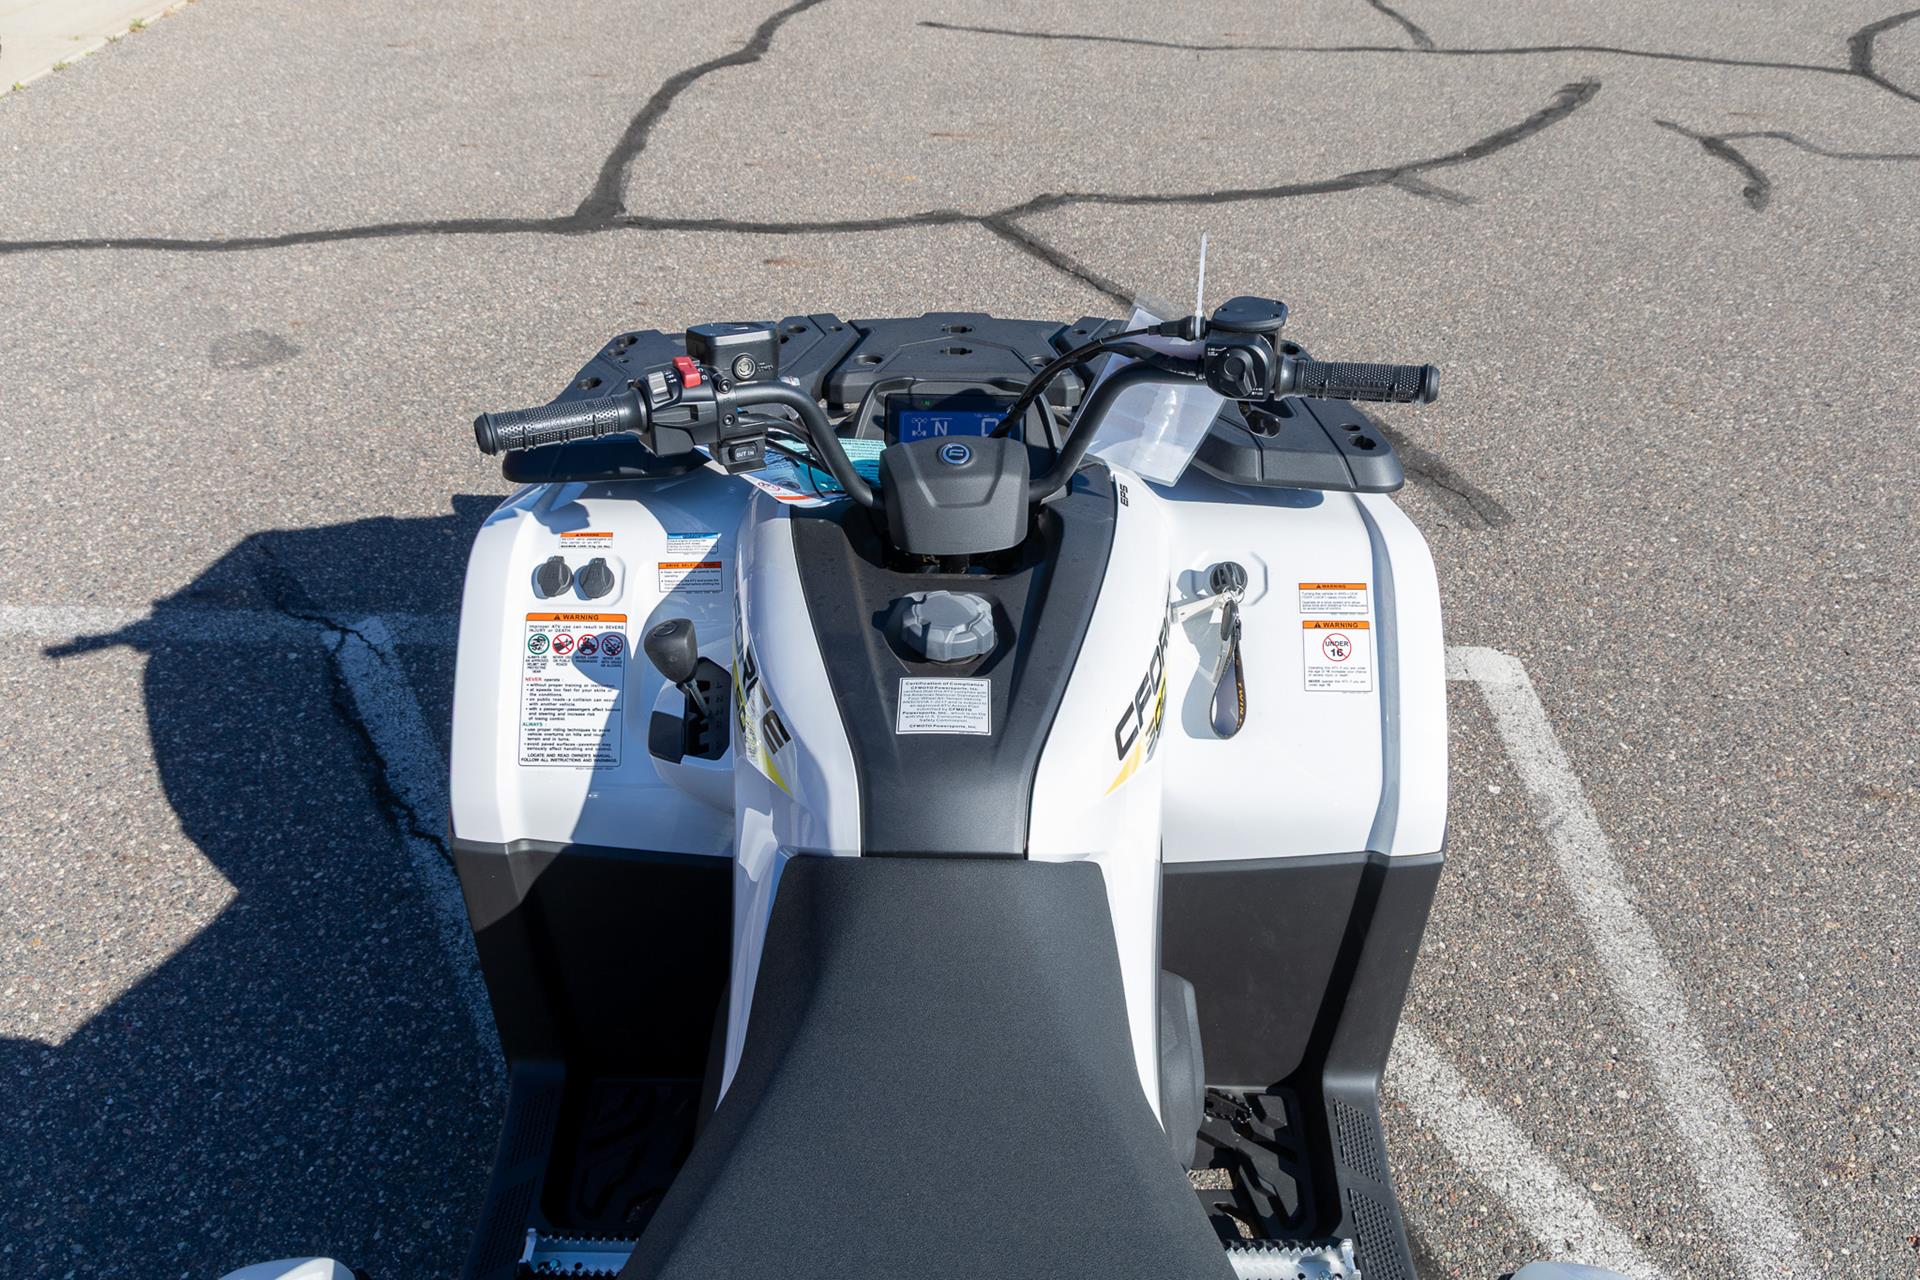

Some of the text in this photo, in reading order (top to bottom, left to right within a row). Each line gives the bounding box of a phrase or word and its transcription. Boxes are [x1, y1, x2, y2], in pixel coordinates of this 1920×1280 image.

[934, 420, 948, 436] N
[1120, 483, 1128, 506] EPS
[1330, 648, 1344, 657] 16
